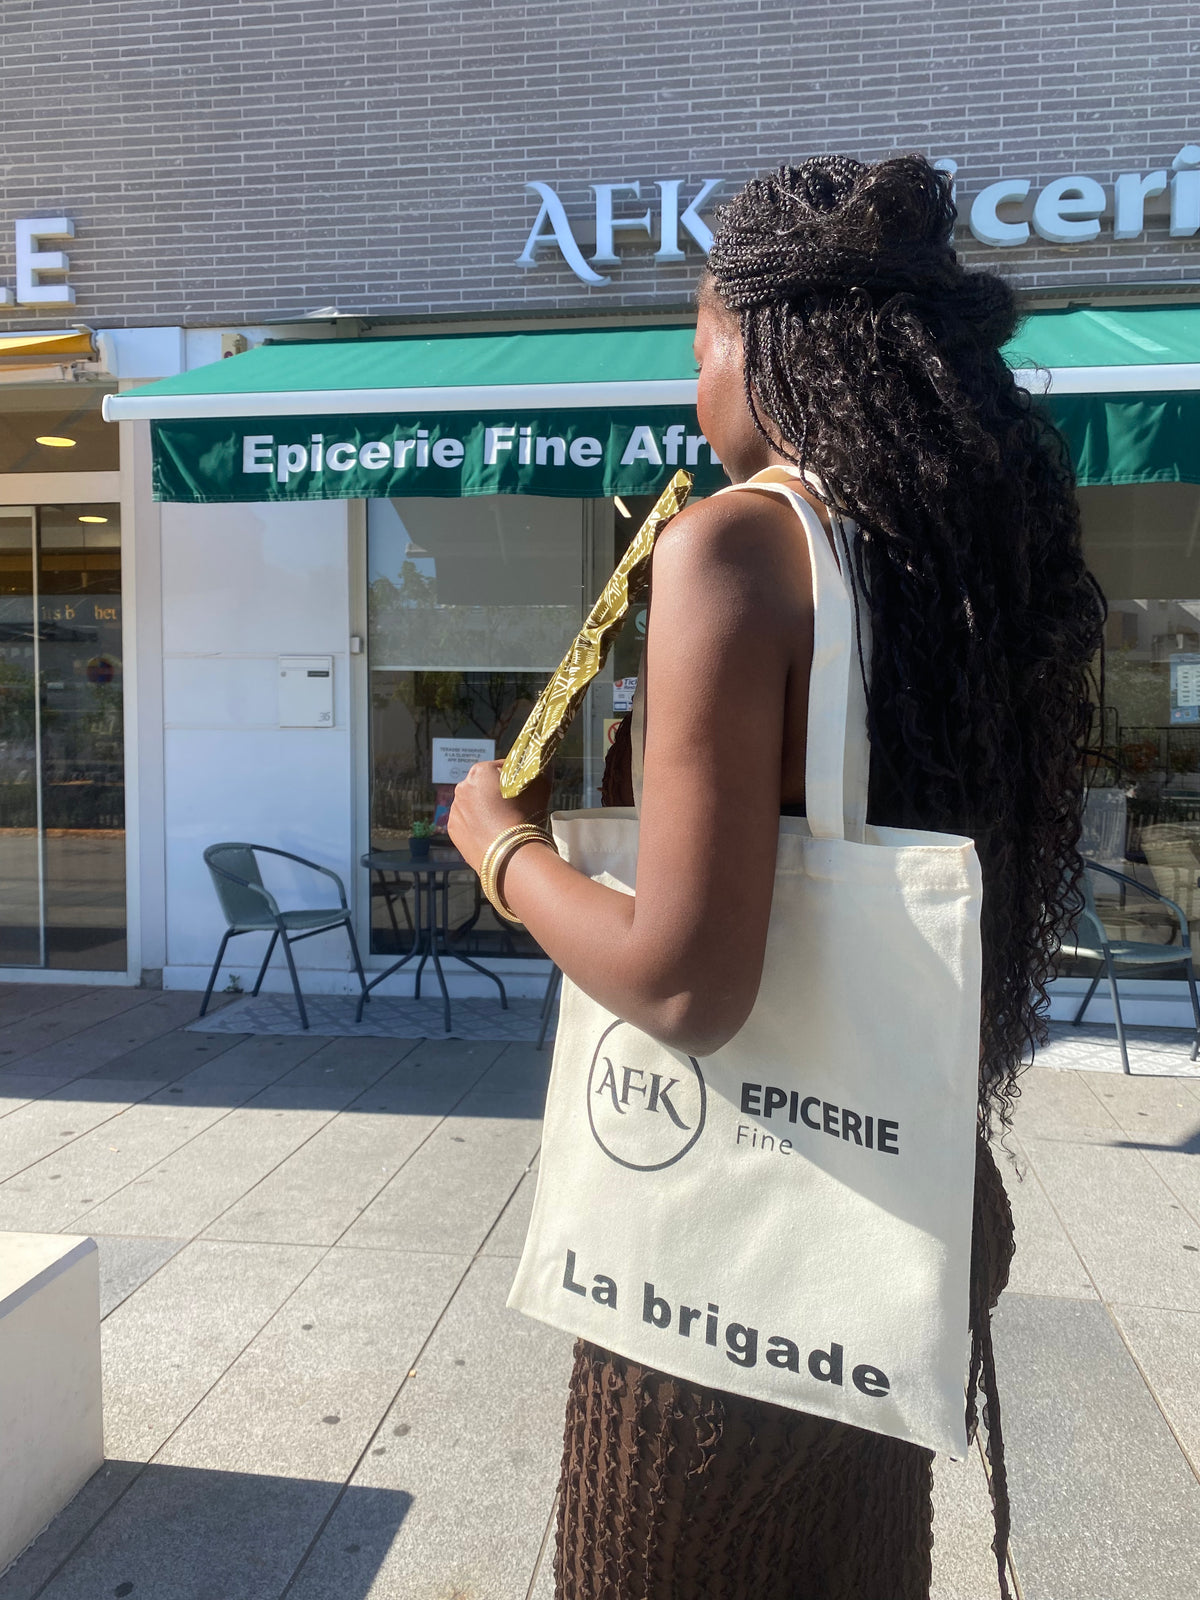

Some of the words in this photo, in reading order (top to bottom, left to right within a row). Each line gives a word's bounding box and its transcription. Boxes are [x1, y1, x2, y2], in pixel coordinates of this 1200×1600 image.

[0, 217, 76, 309] E
[514, 178, 726, 287] AFK
[242, 429, 465, 483] Epicerie
[484, 426, 602, 468] Fine
[595, 1056, 691, 1131] AFK
[740, 1082, 900, 1156] EPICERIE
[736, 1124, 793, 1156] Fine
[562, 1248, 619, 1310] La
[642, 1281, 891, 1398] brigade
